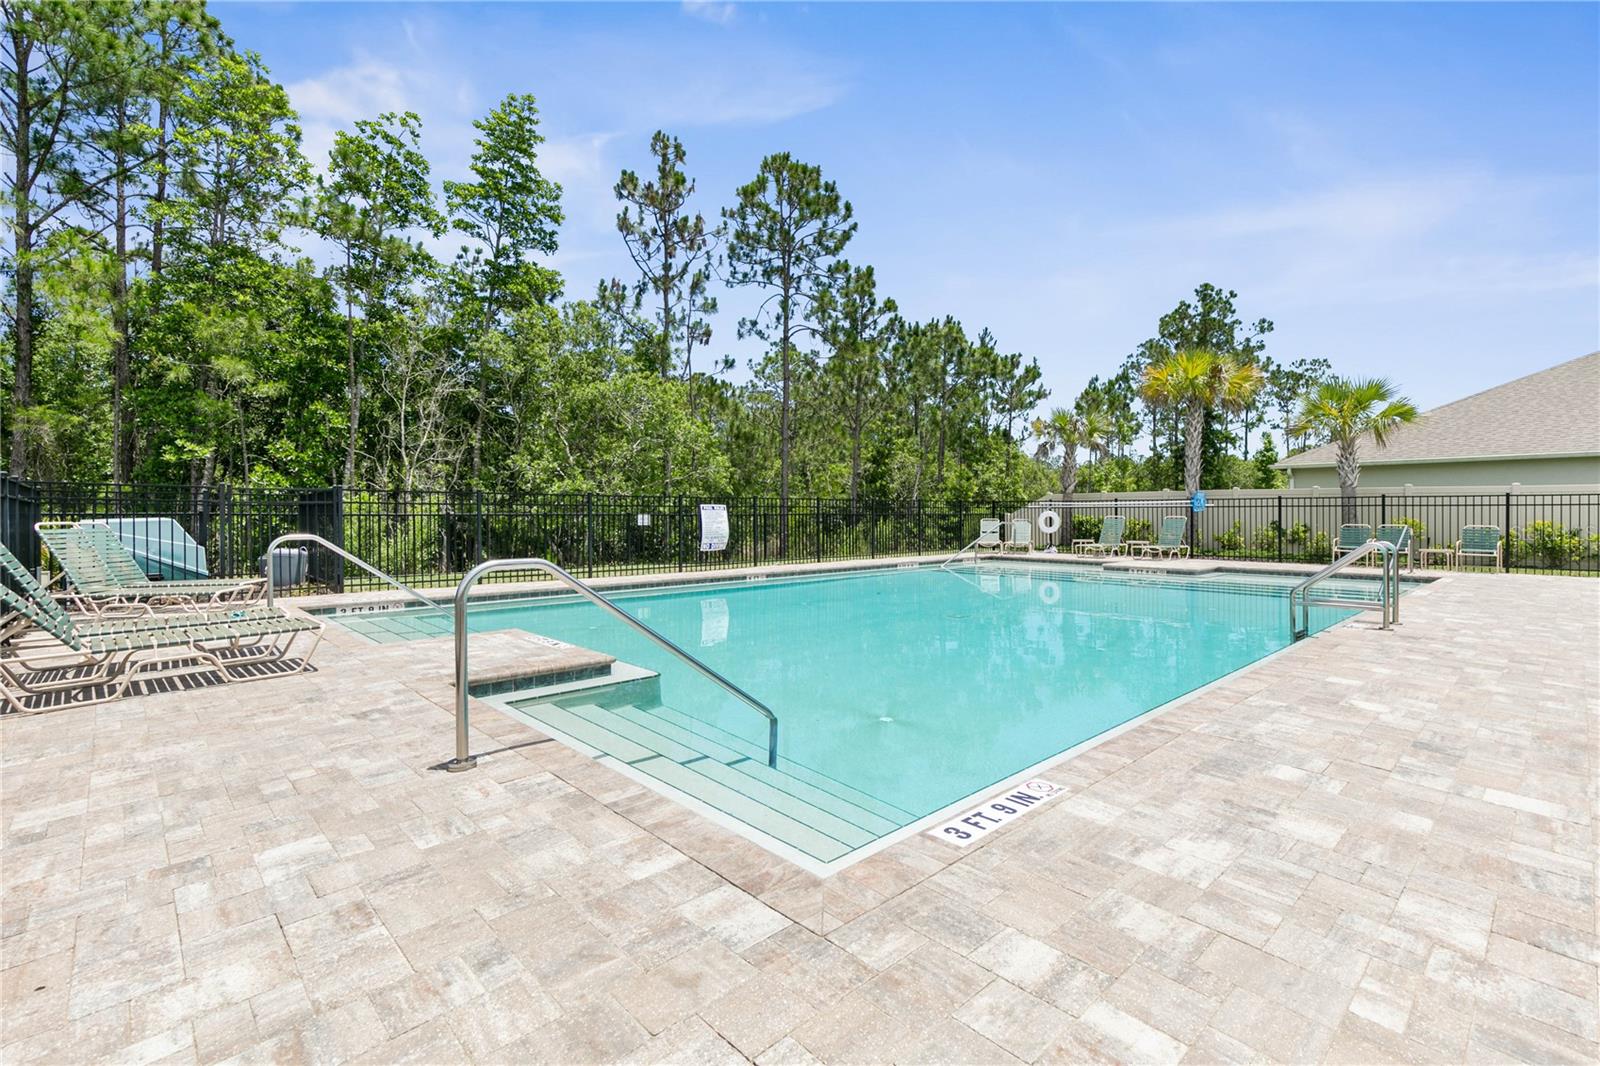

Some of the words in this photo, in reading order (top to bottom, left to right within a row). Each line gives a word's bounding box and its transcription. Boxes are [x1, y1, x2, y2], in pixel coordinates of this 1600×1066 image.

[943, 826, 972, 840] 3
[960, 811, 1002, 830] FT.
[990, 803, 1018, 815] 9
